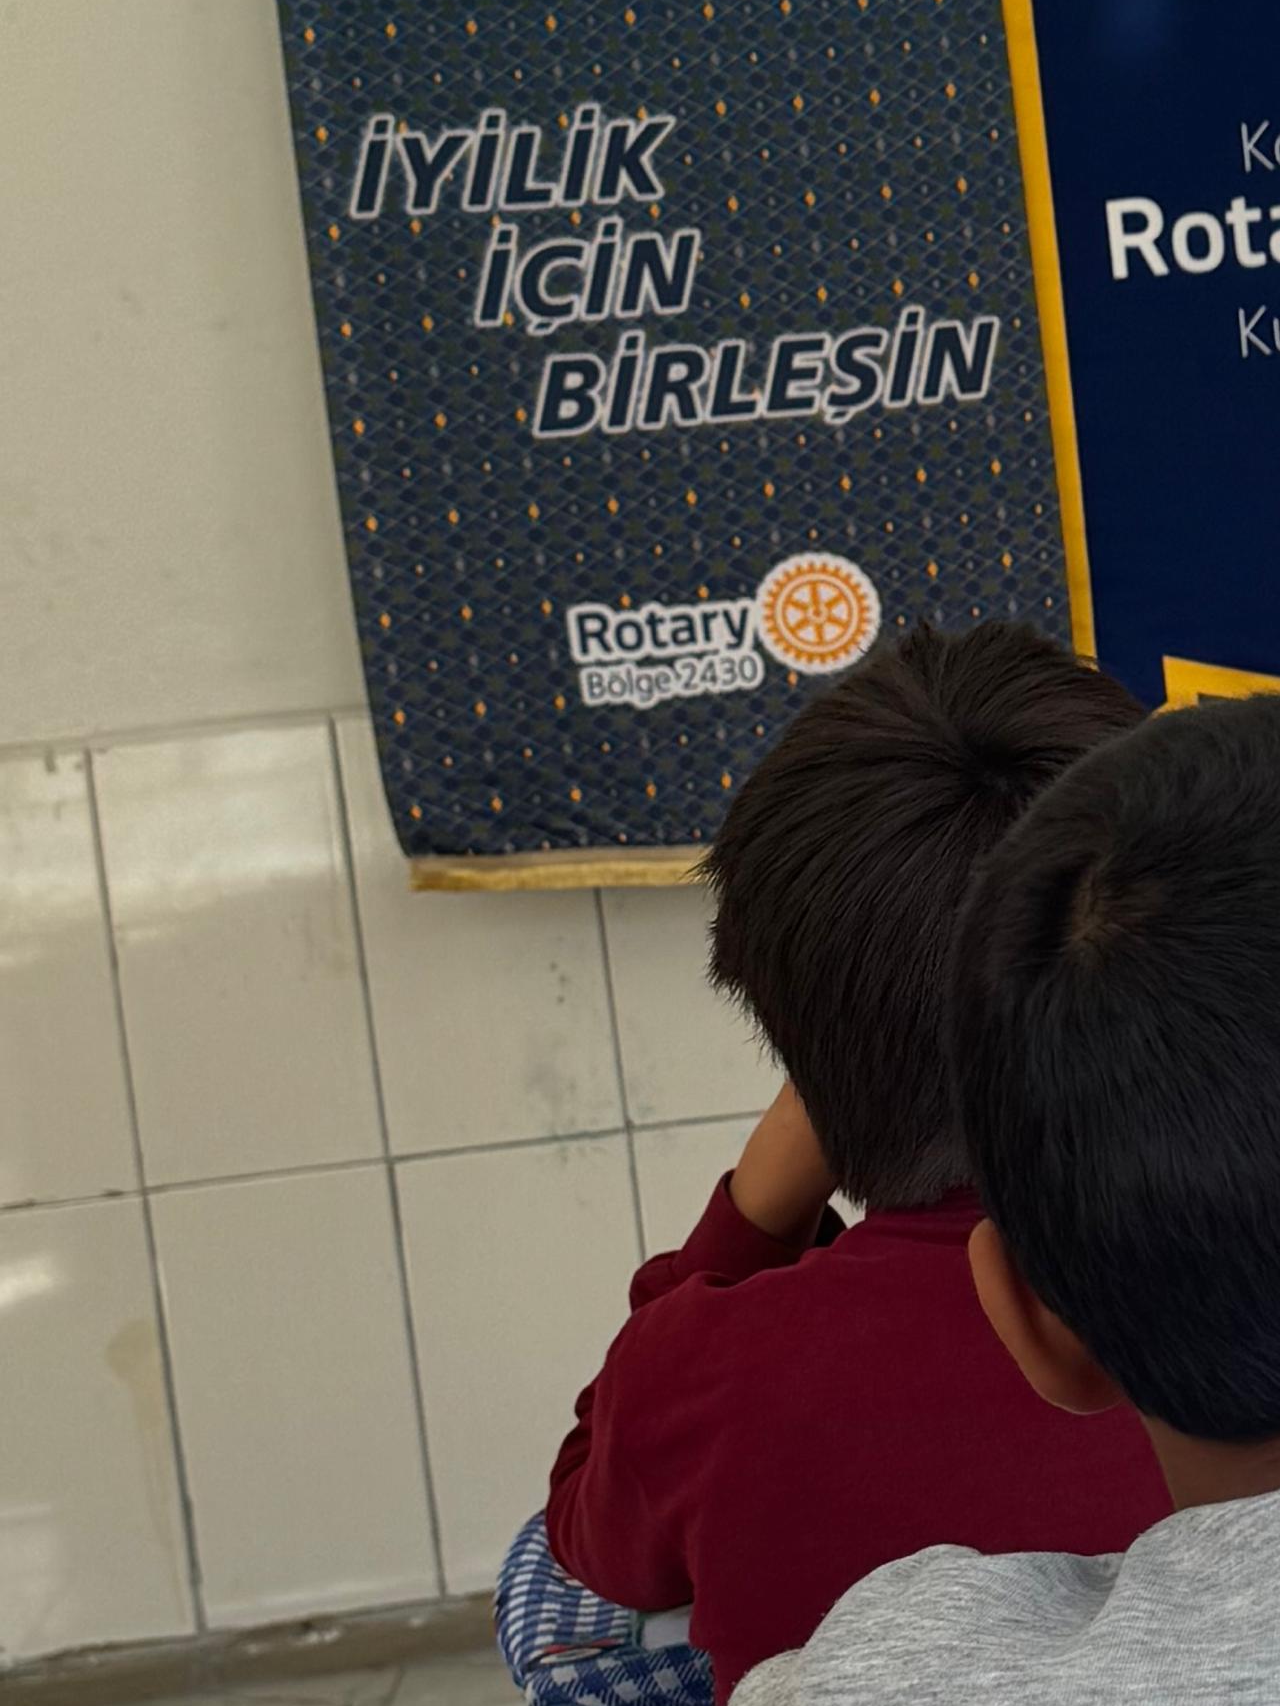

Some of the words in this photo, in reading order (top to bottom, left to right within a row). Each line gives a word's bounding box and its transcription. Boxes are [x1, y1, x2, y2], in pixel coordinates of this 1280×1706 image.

[349, 102, 676, 220] İYİLİK
[475, 216, 700, 336] İÇİN
[533, 305, 999, 439] BİRLEŞİN
[575, 604, 750, 656] Rotary
[586, 667, 672, 701] Bölge
[677, 656, 759, 691] 2430
